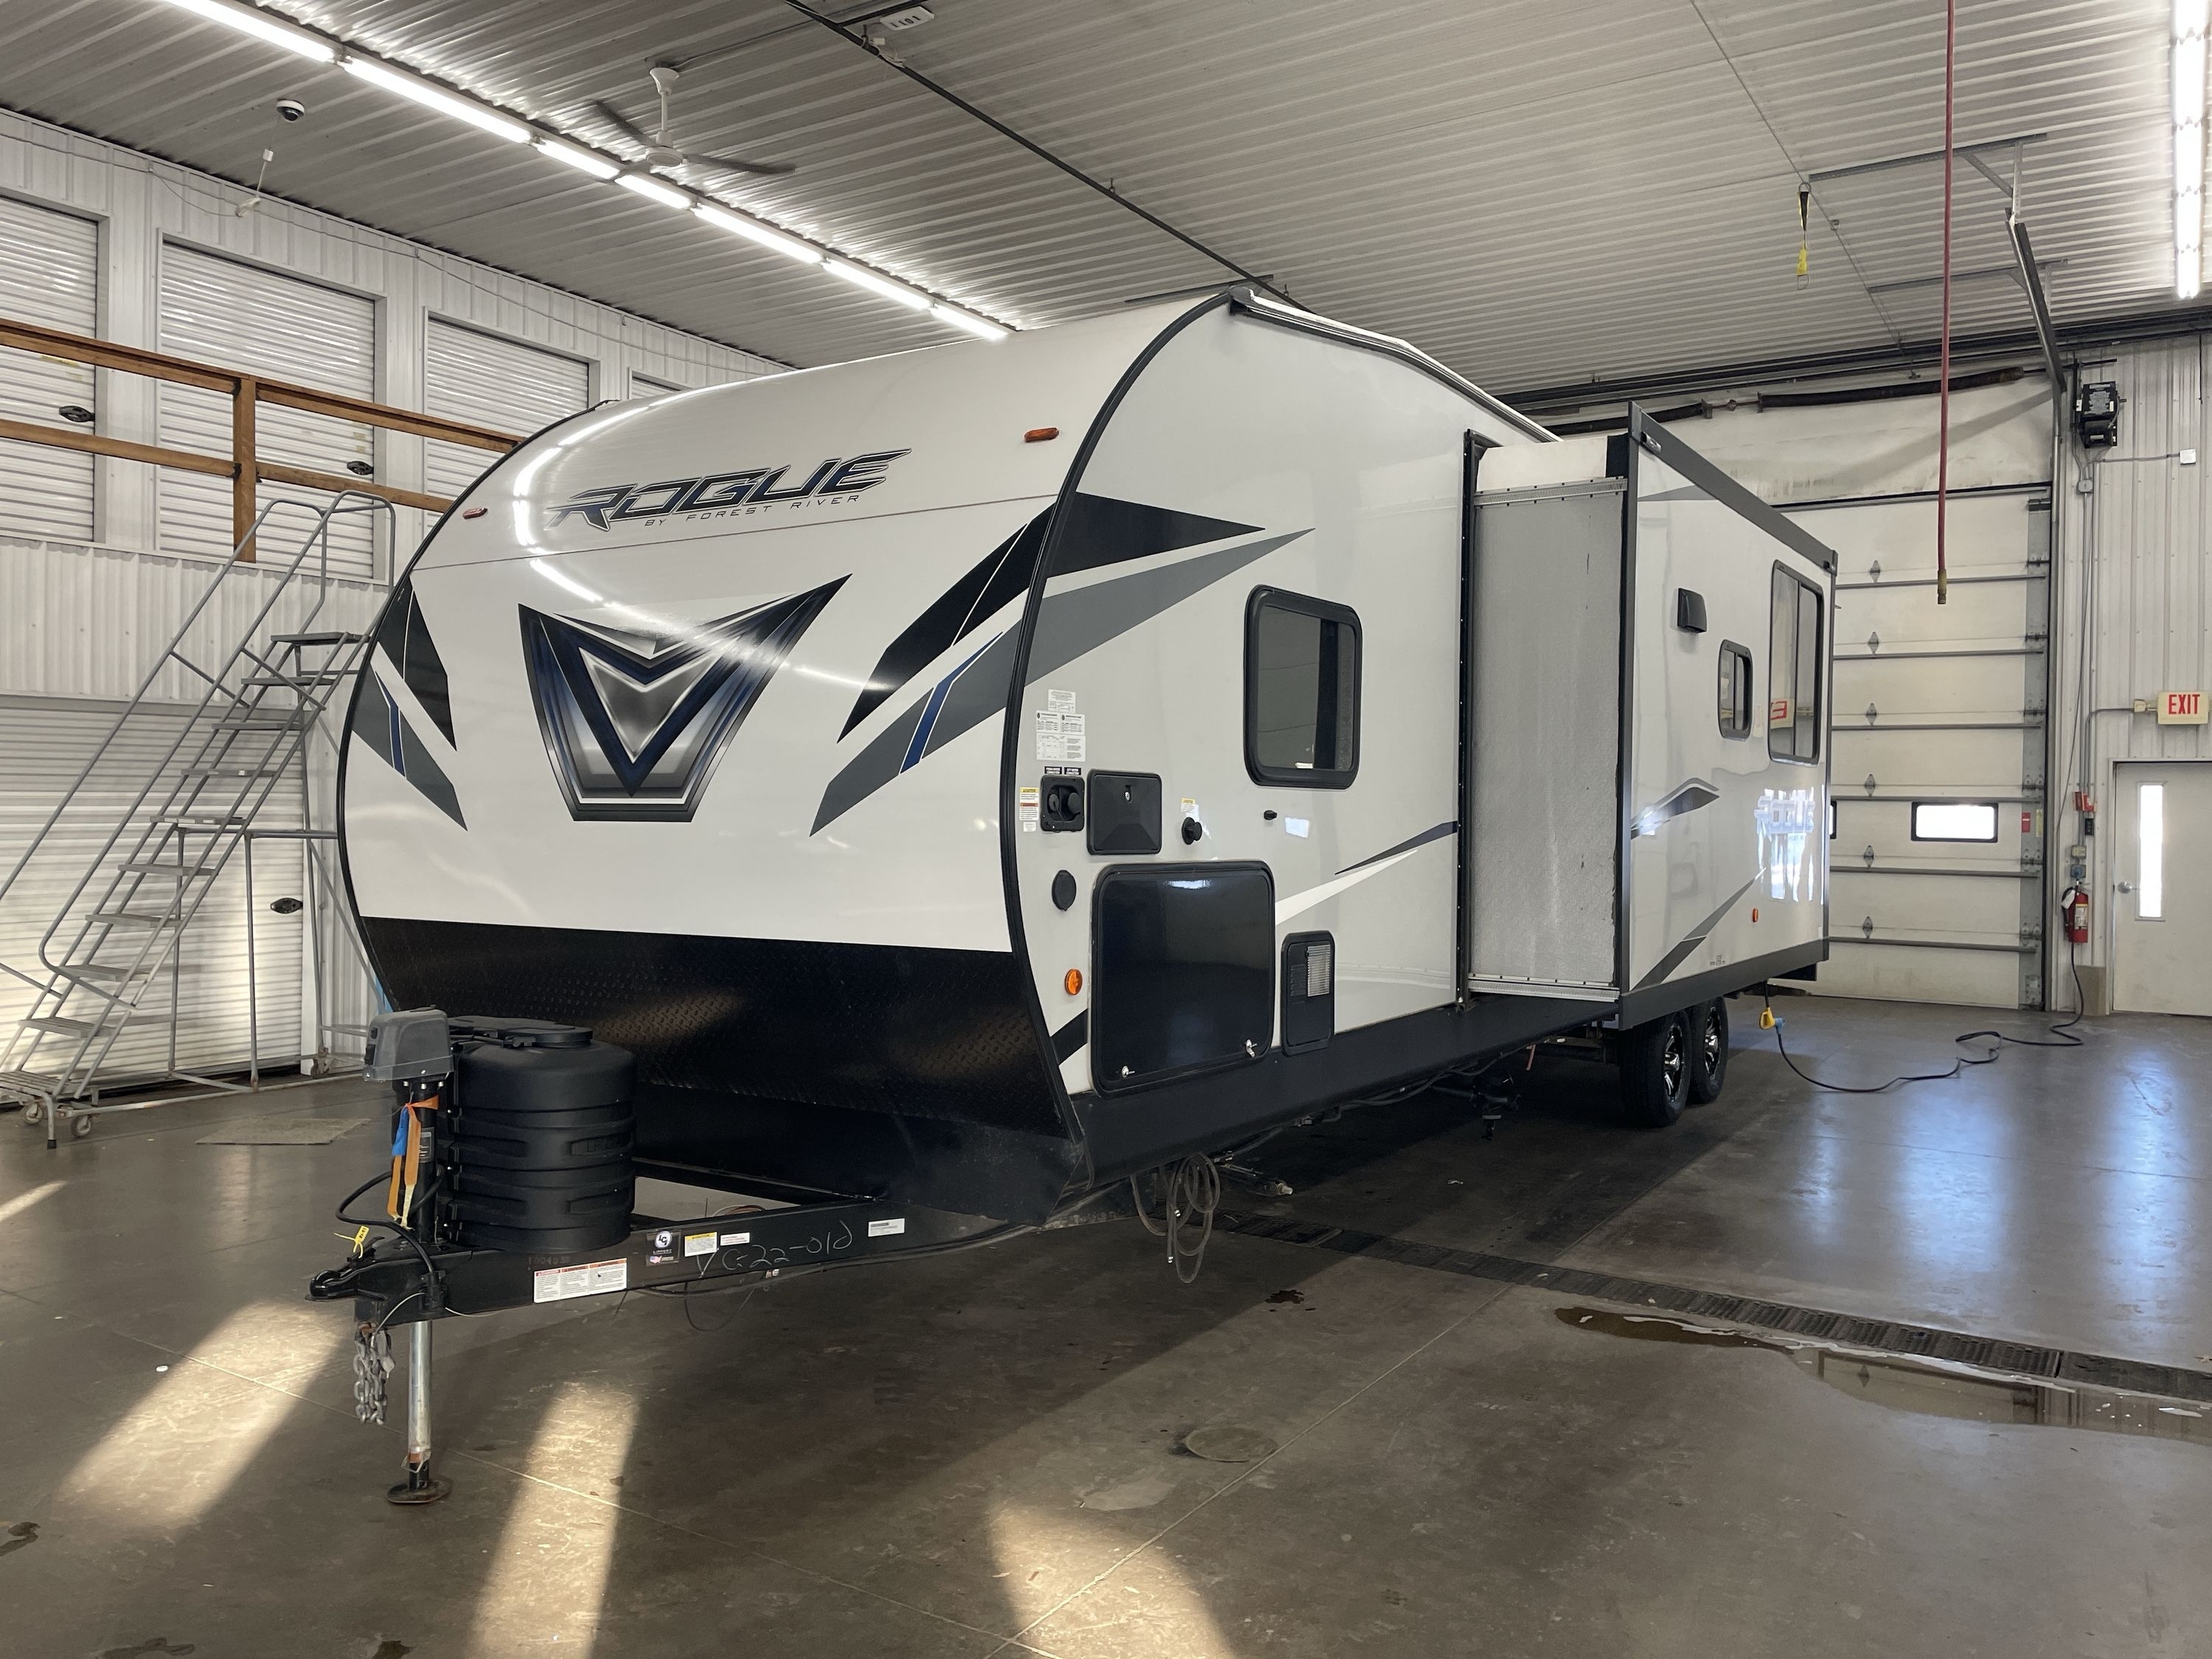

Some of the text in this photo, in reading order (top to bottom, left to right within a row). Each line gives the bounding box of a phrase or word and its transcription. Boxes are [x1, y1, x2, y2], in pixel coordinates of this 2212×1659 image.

[543, 448, 911, 531] ROGUE
[644, 494, 860, 527] BY FOREST RIVER
[2168, 694, 2200, 714] EXIT
